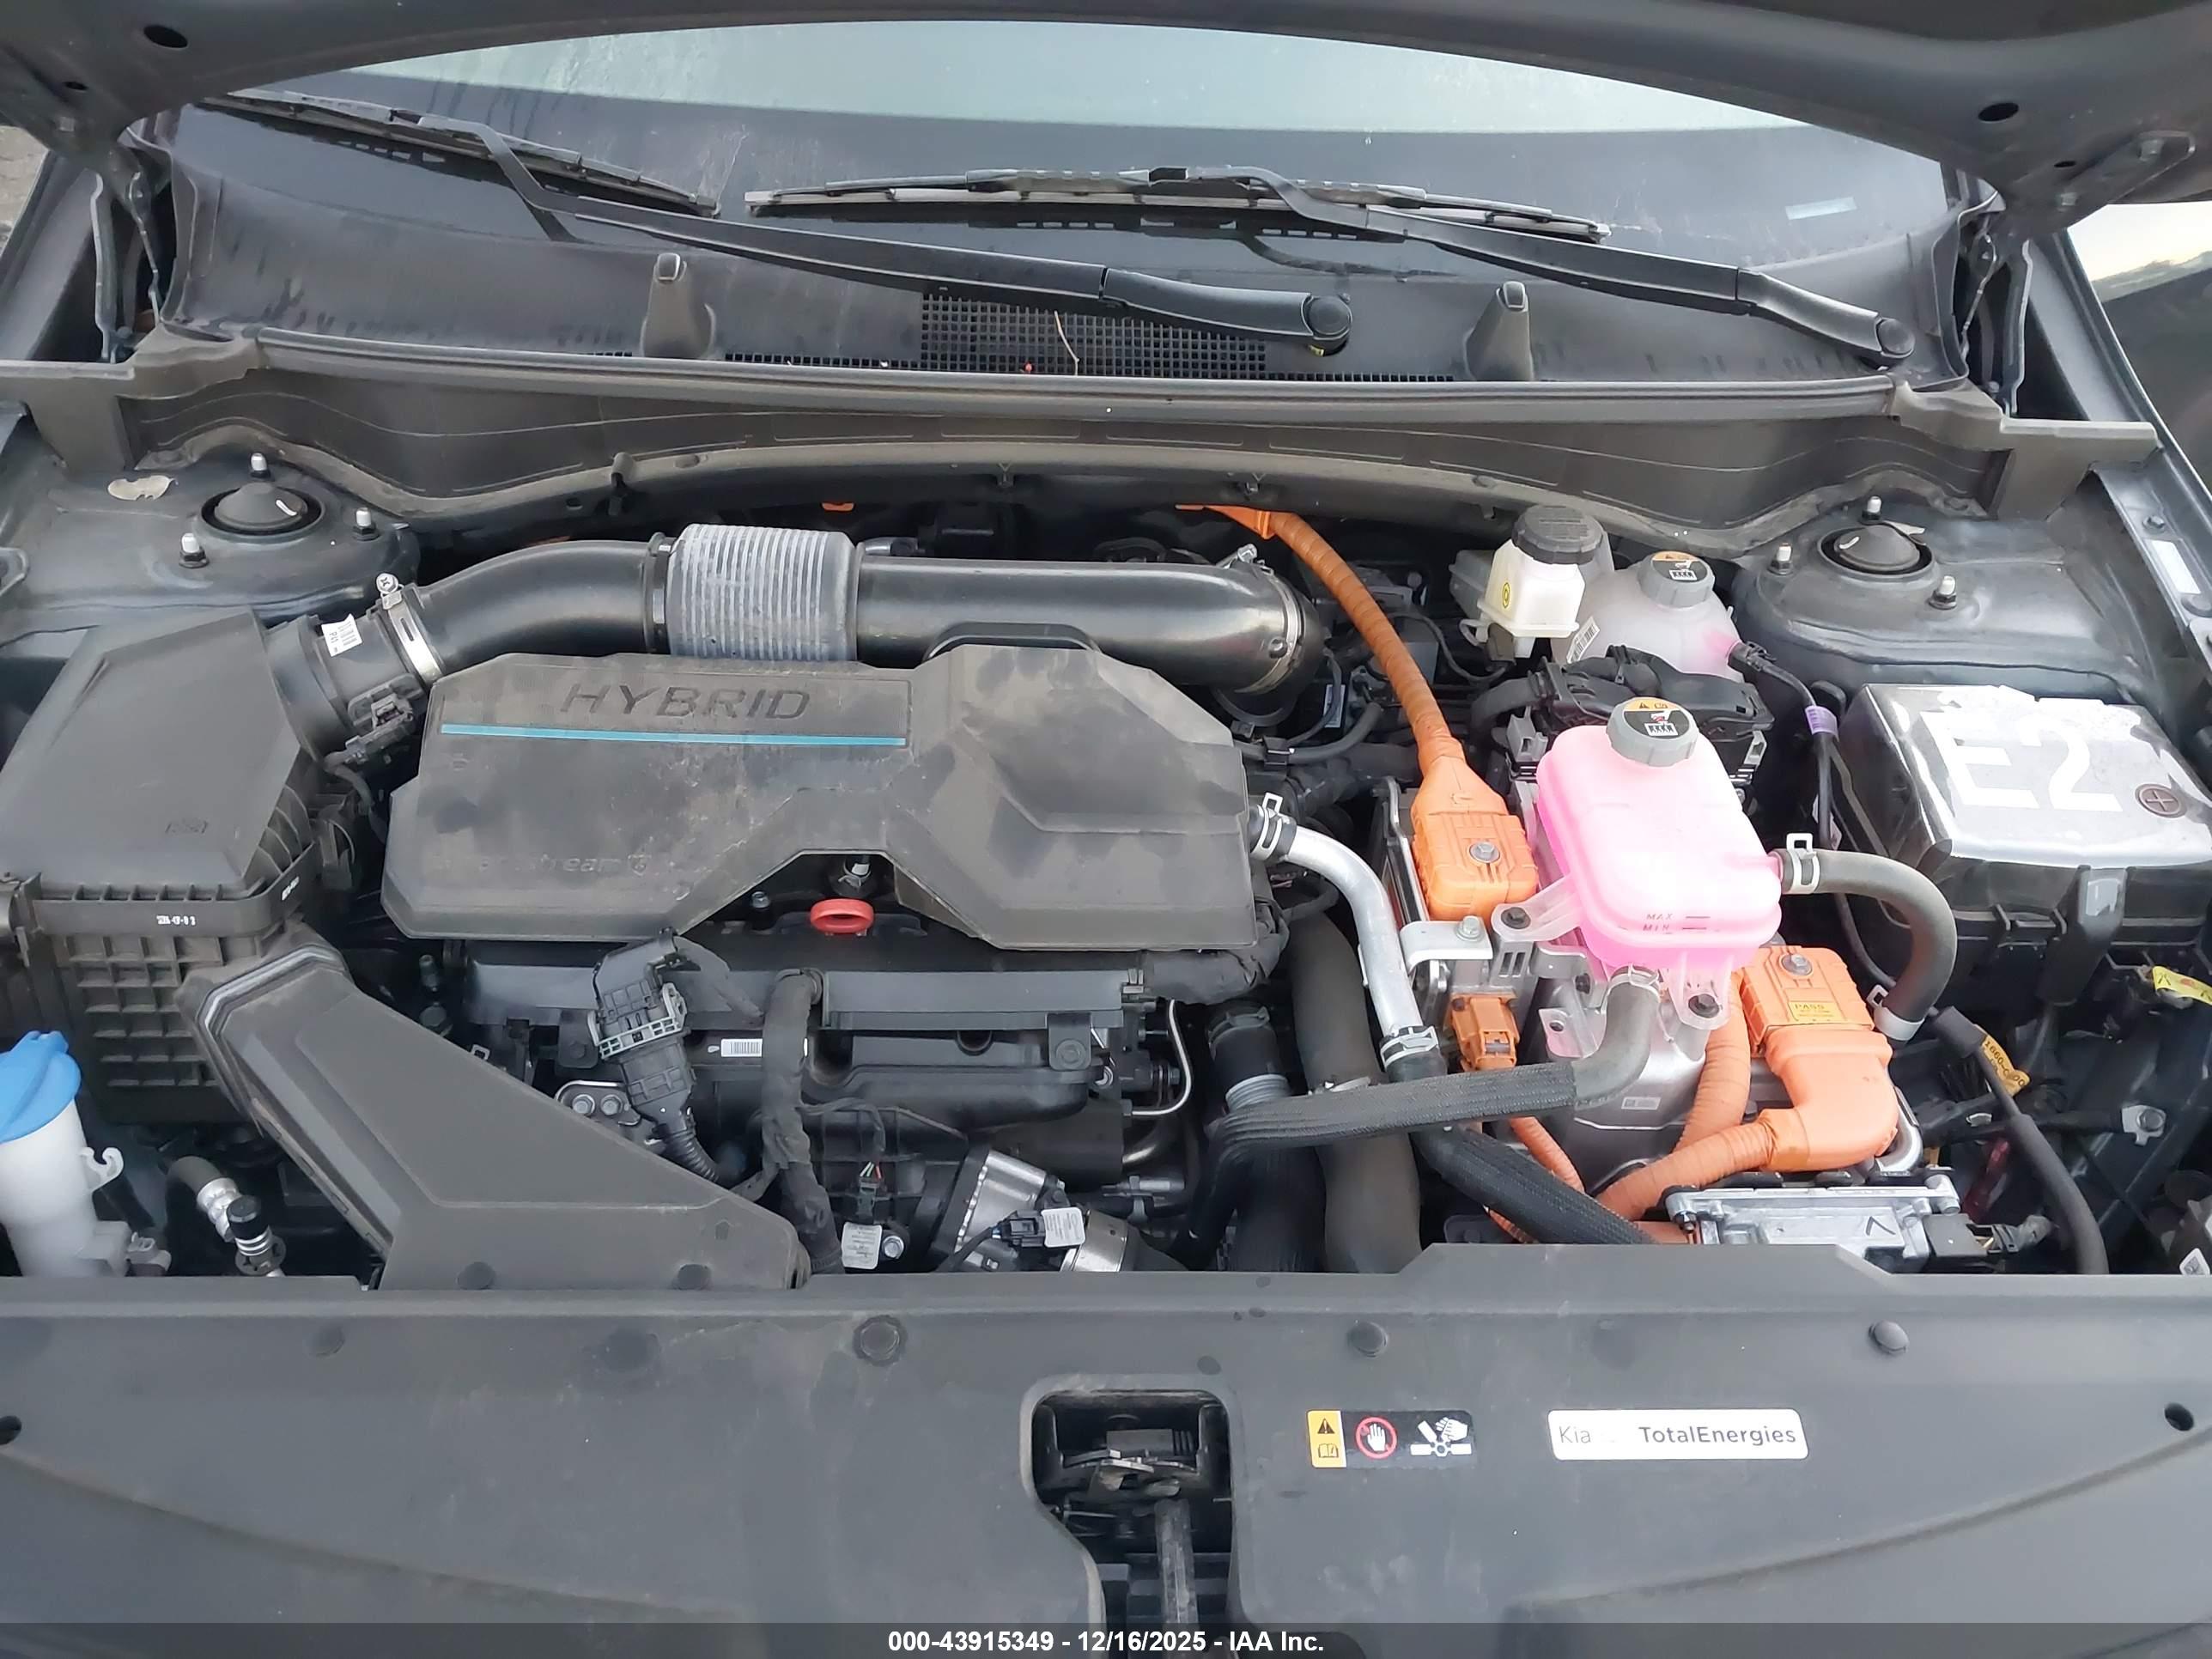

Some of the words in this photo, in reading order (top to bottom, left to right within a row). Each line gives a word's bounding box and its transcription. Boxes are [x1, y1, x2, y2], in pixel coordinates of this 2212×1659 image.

[560, 684, 811, 719] HYBRID
[1920, 711, 2123, 811] E2
[1559, 1425, 1590, 1443] Kia
[1638, 1425, 1796, 1446] TotalEnergies
